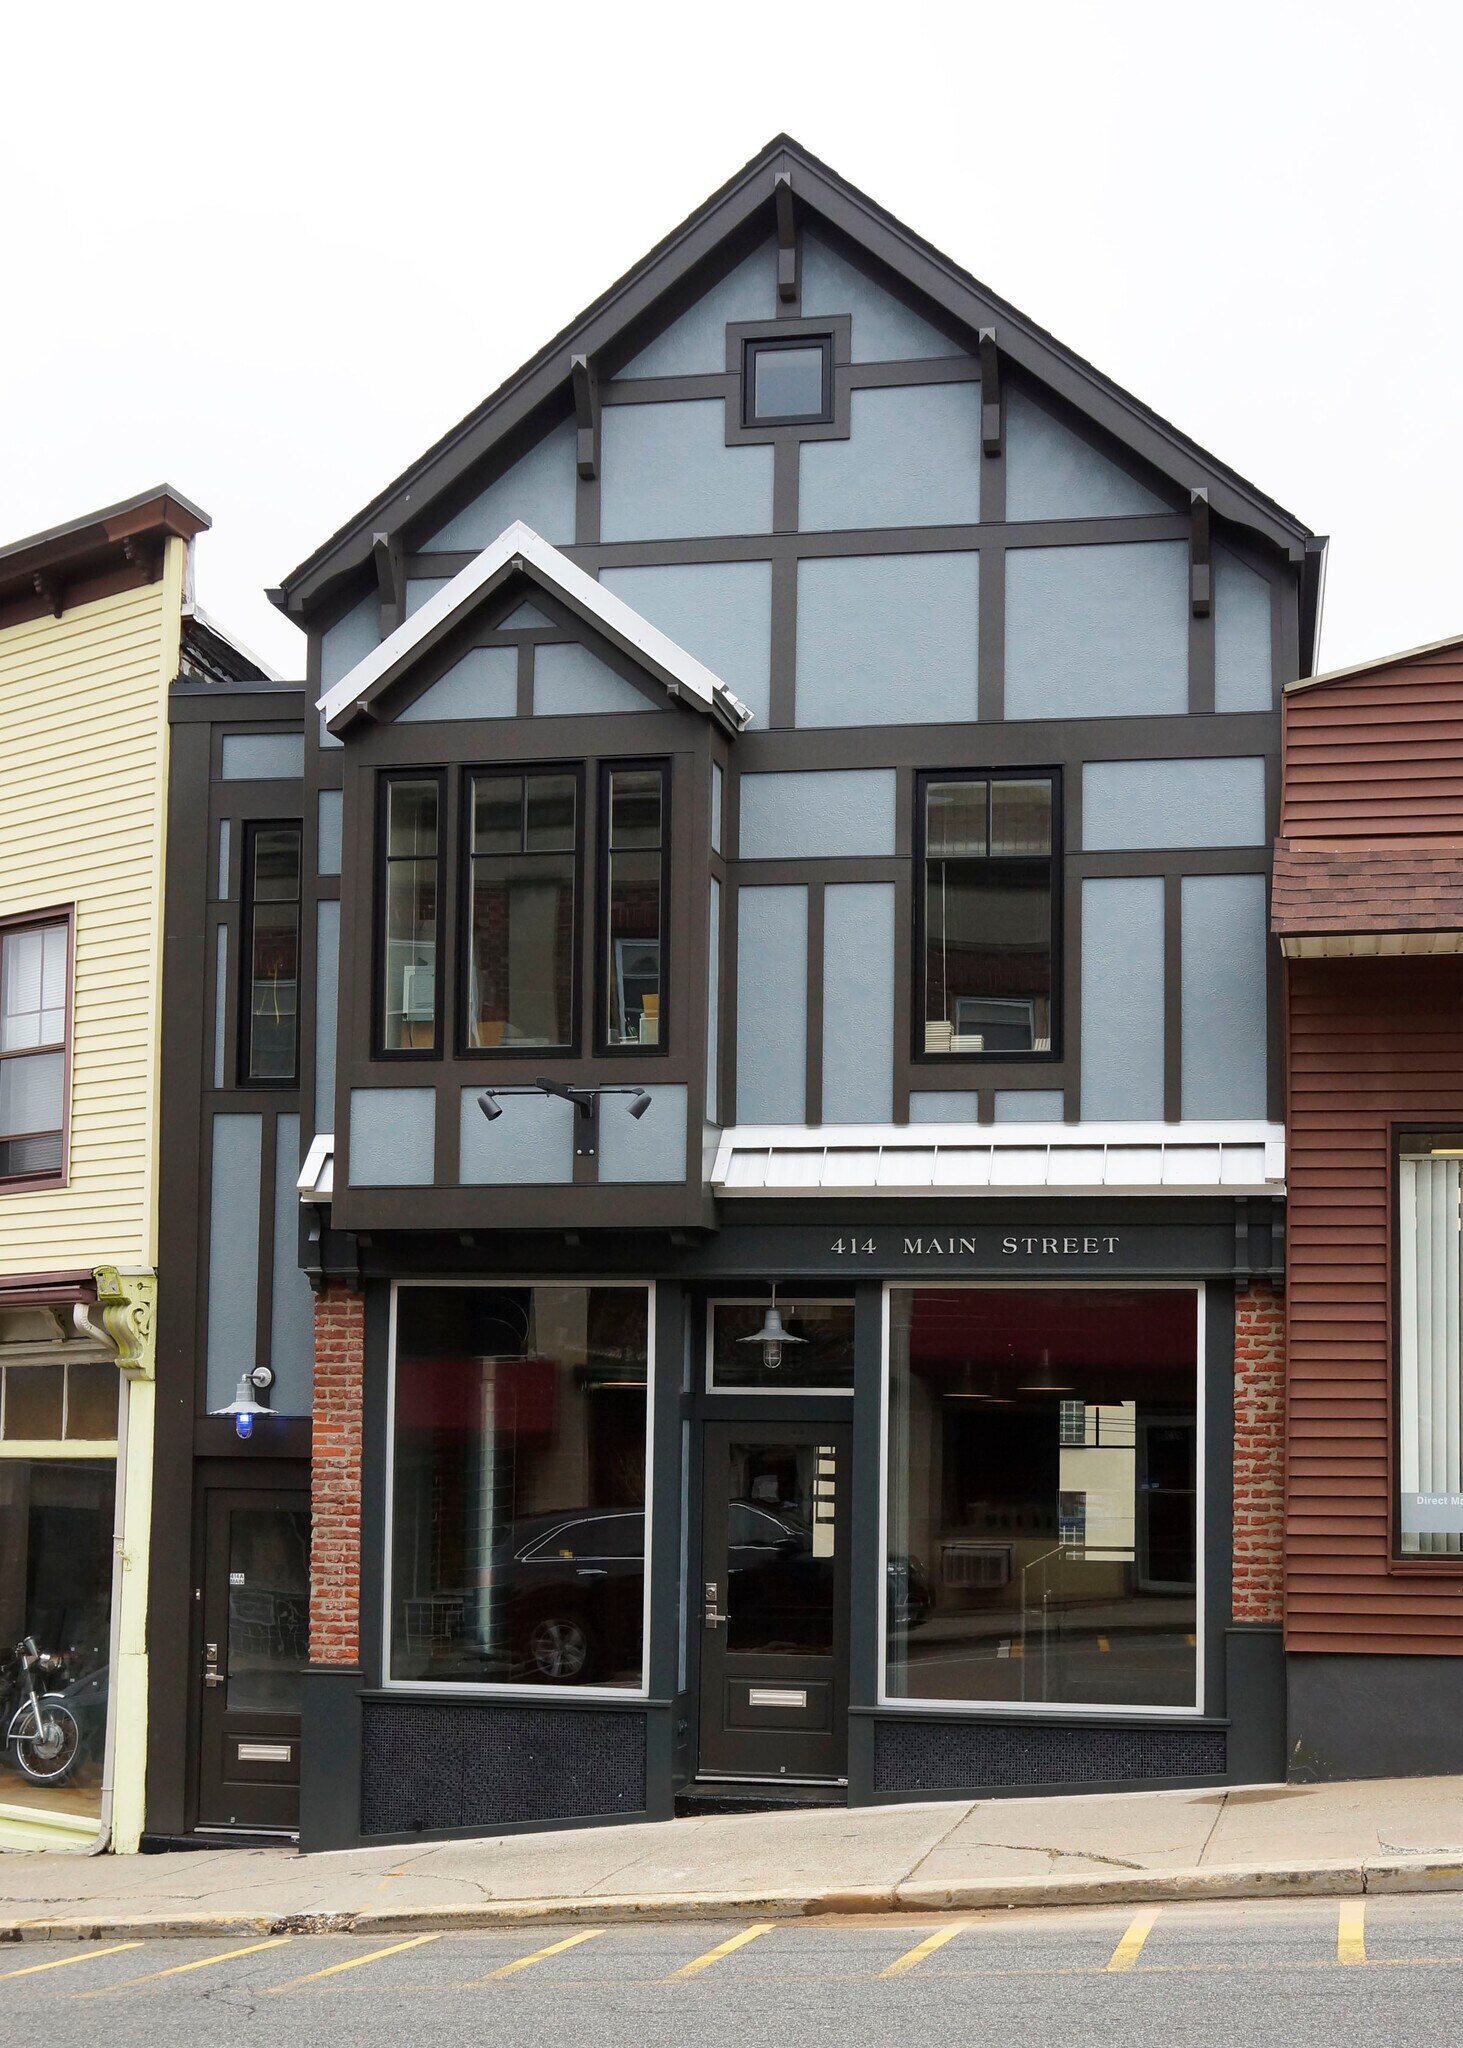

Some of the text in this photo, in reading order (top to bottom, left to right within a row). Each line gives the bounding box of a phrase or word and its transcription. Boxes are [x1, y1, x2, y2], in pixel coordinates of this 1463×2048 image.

[830, 1237, 1120, 1254] 414 MAIN STREET
[1416, 1496, 1448, 1505] Direct
